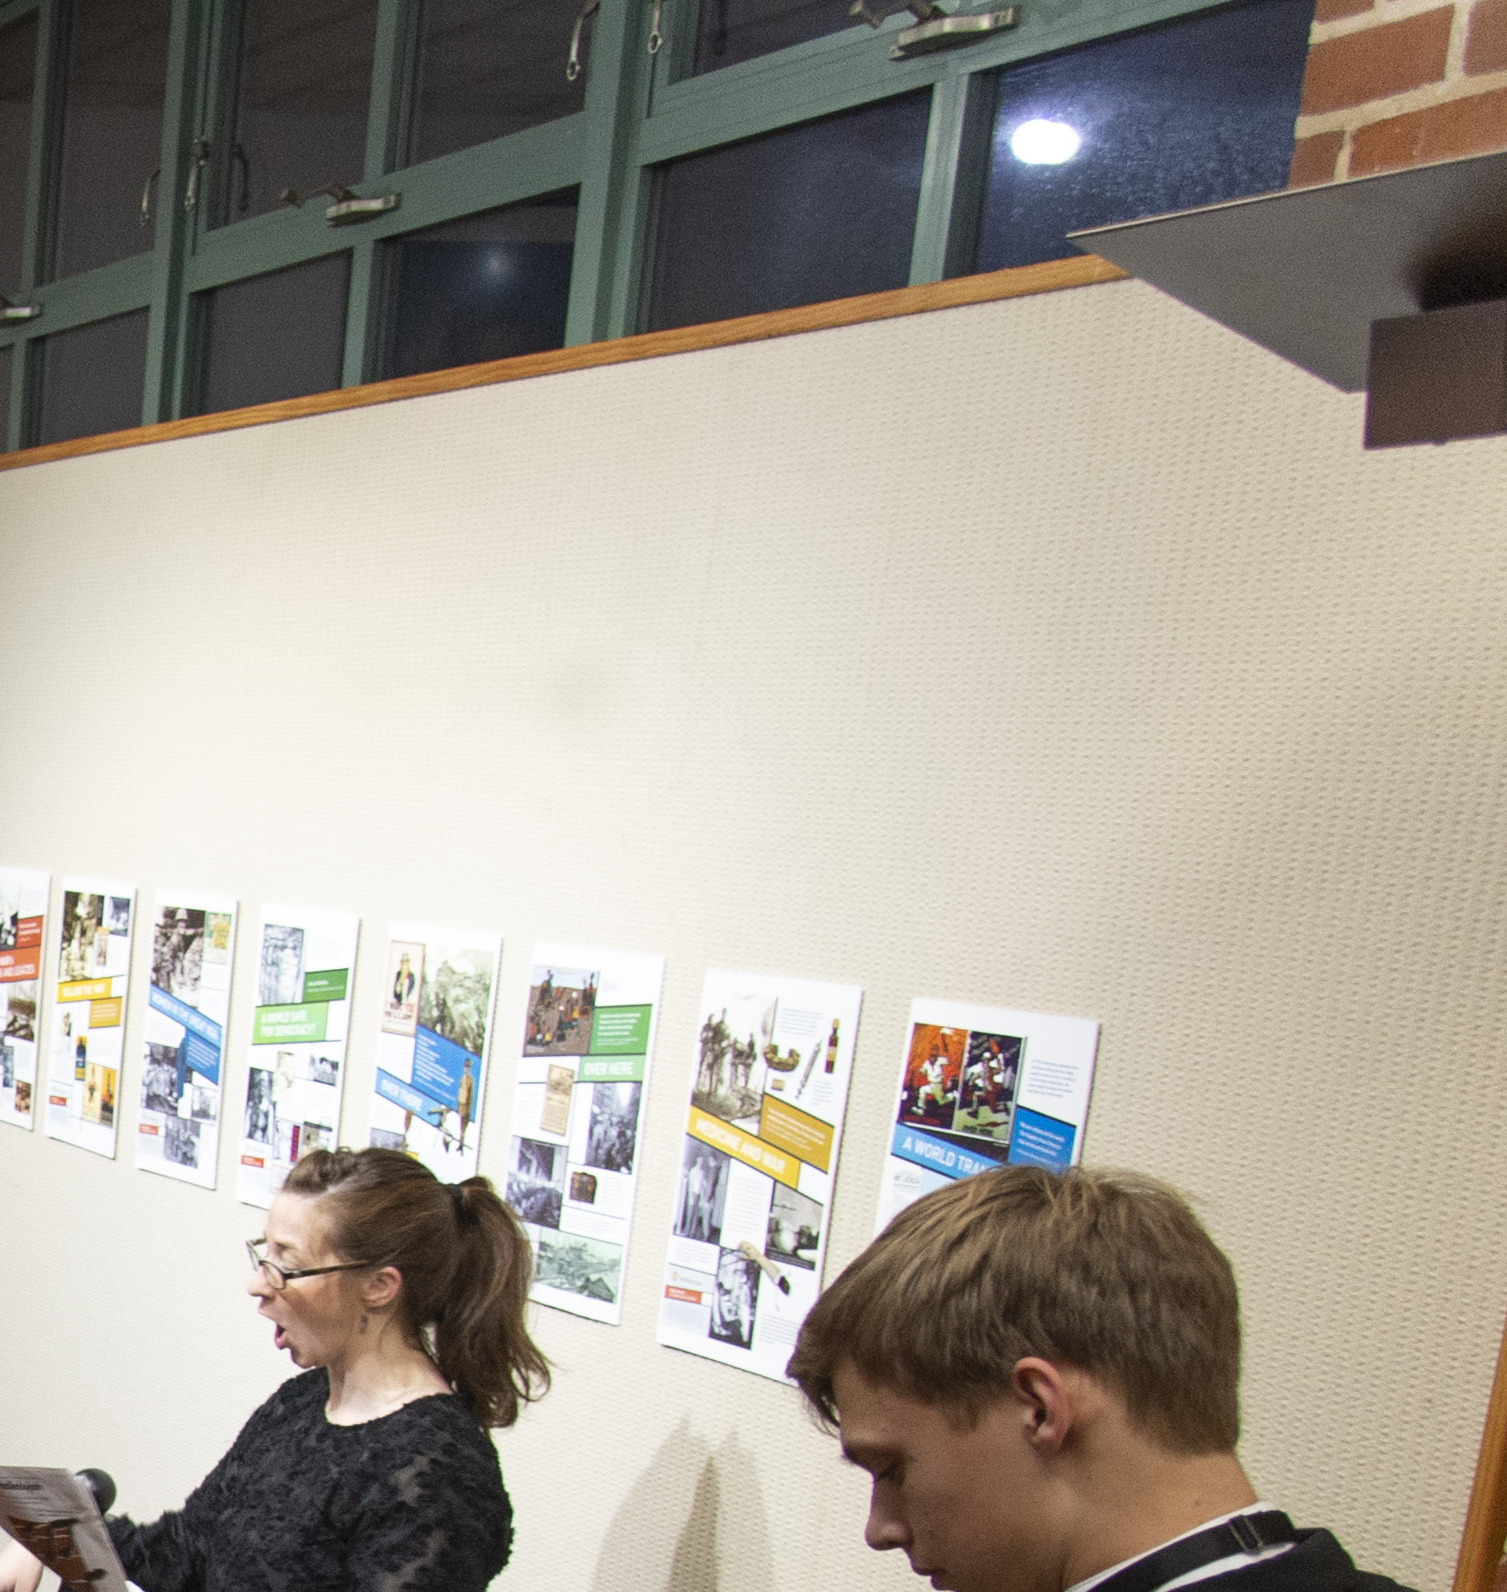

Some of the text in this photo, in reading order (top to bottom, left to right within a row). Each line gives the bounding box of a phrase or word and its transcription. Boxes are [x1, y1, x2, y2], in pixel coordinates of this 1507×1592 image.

[584, 1061, 634, 1076] OVER HERE
[740, 1141, 763, 1162] AND
[763, 1151, 786, 1174] WAR
[902, 1136, 913, 1151] A
[914, 1140, 955, 1167] WORLD
